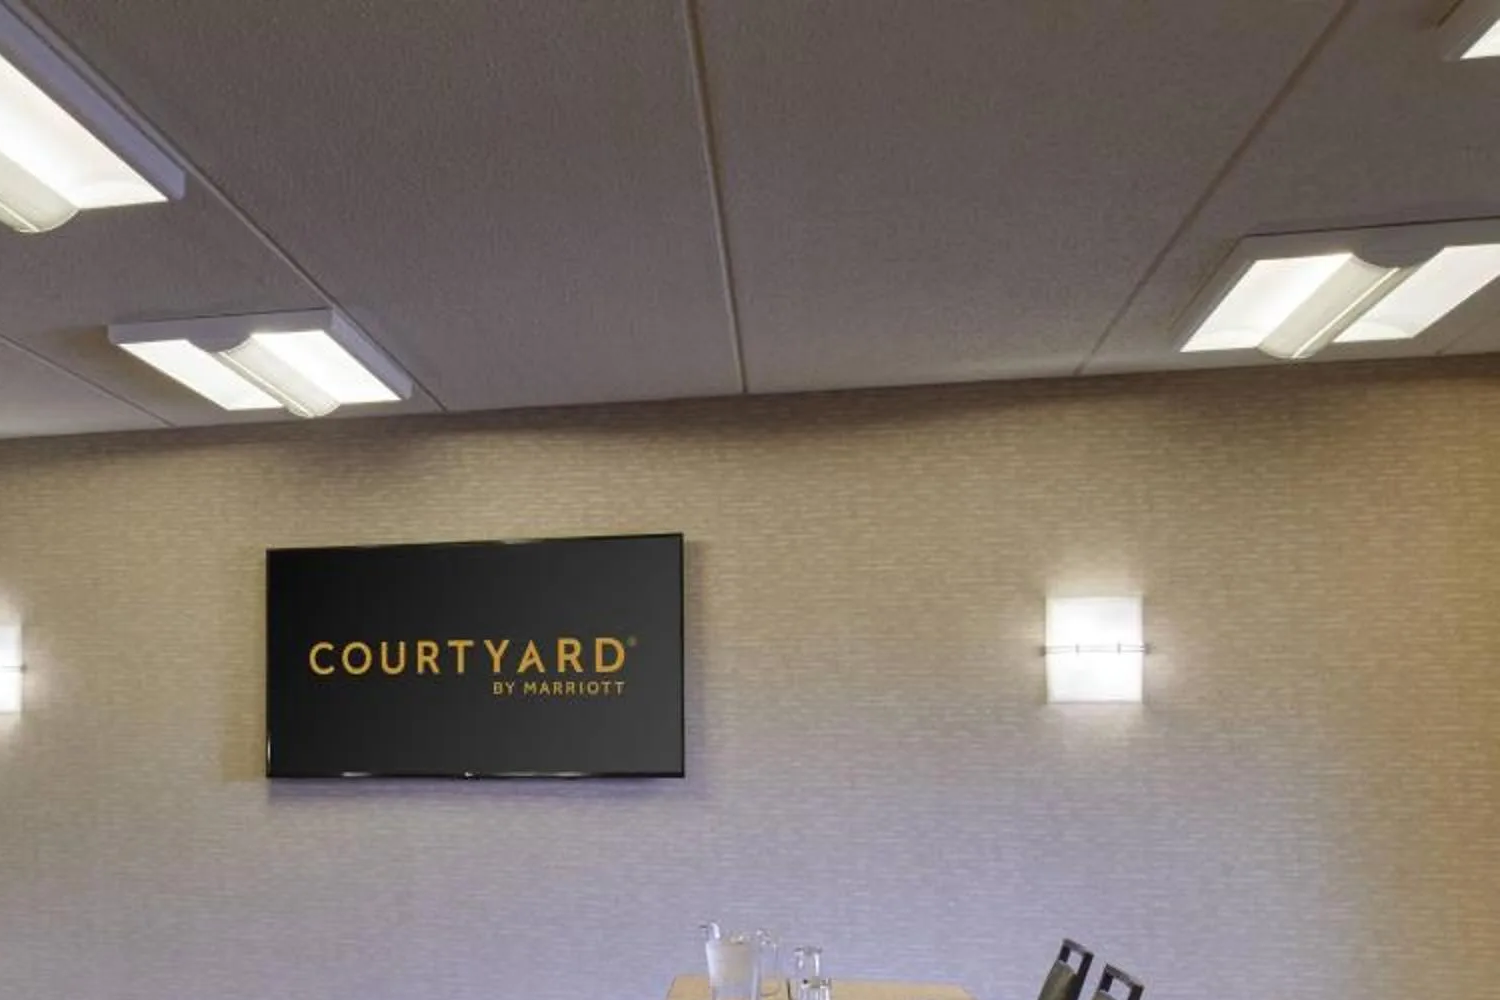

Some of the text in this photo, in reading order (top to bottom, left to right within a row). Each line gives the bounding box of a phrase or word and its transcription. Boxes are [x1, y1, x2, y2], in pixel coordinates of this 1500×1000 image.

[308, 636, 627, 676] COURTYARD
[492, 681, 625, 696] BY MARRIOTT
